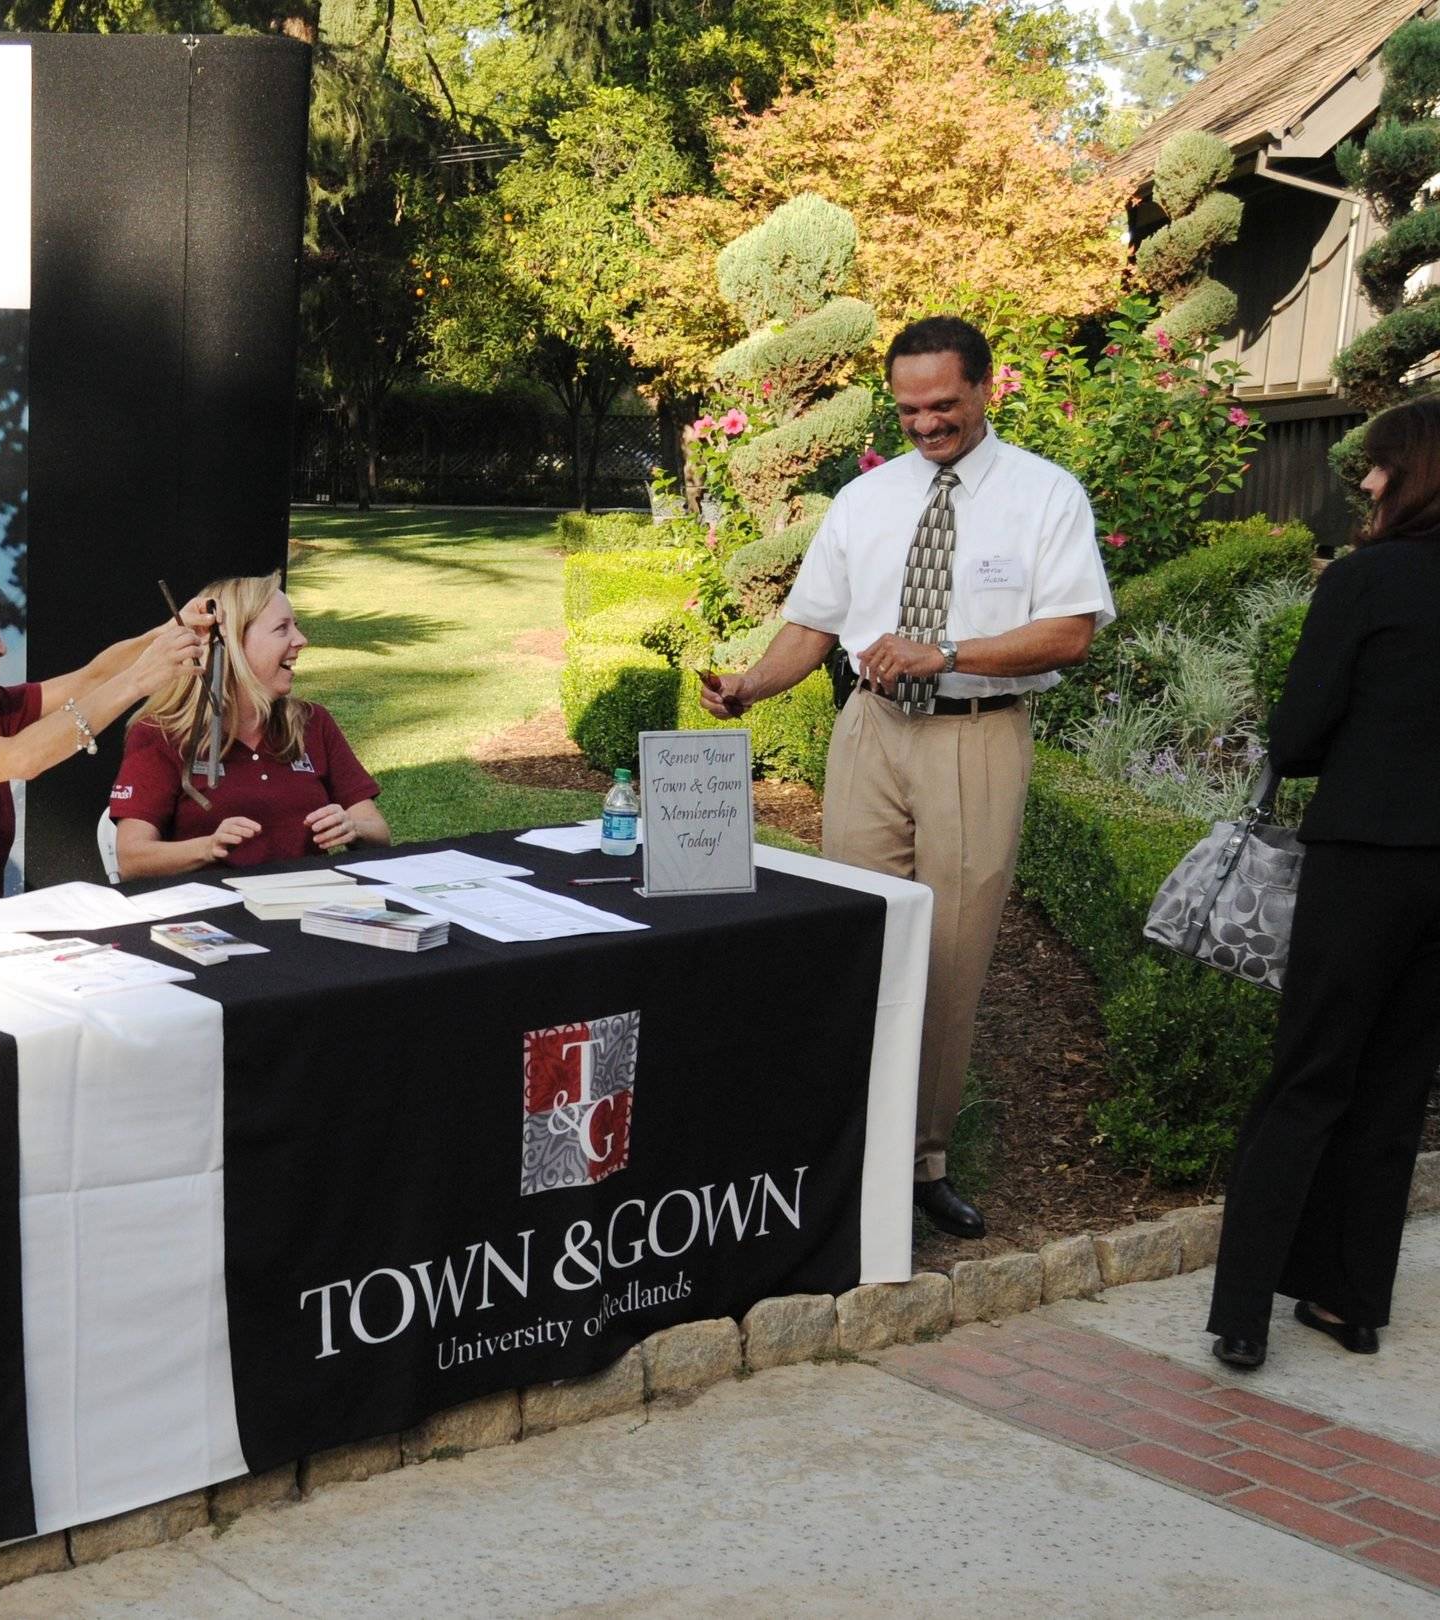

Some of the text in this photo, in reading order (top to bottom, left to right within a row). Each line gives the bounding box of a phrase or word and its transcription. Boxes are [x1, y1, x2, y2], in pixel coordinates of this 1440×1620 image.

[658, 748, 735, 767] Renew Your
[653, 776, 742, 794] Town & Gown
[661, 800, 737, 827] Membership
[677, 829, 722, 856] Today!
[300, 1166, 809, 1360] TOWN & GOWN
[438, 1316, 573, 1370] University
